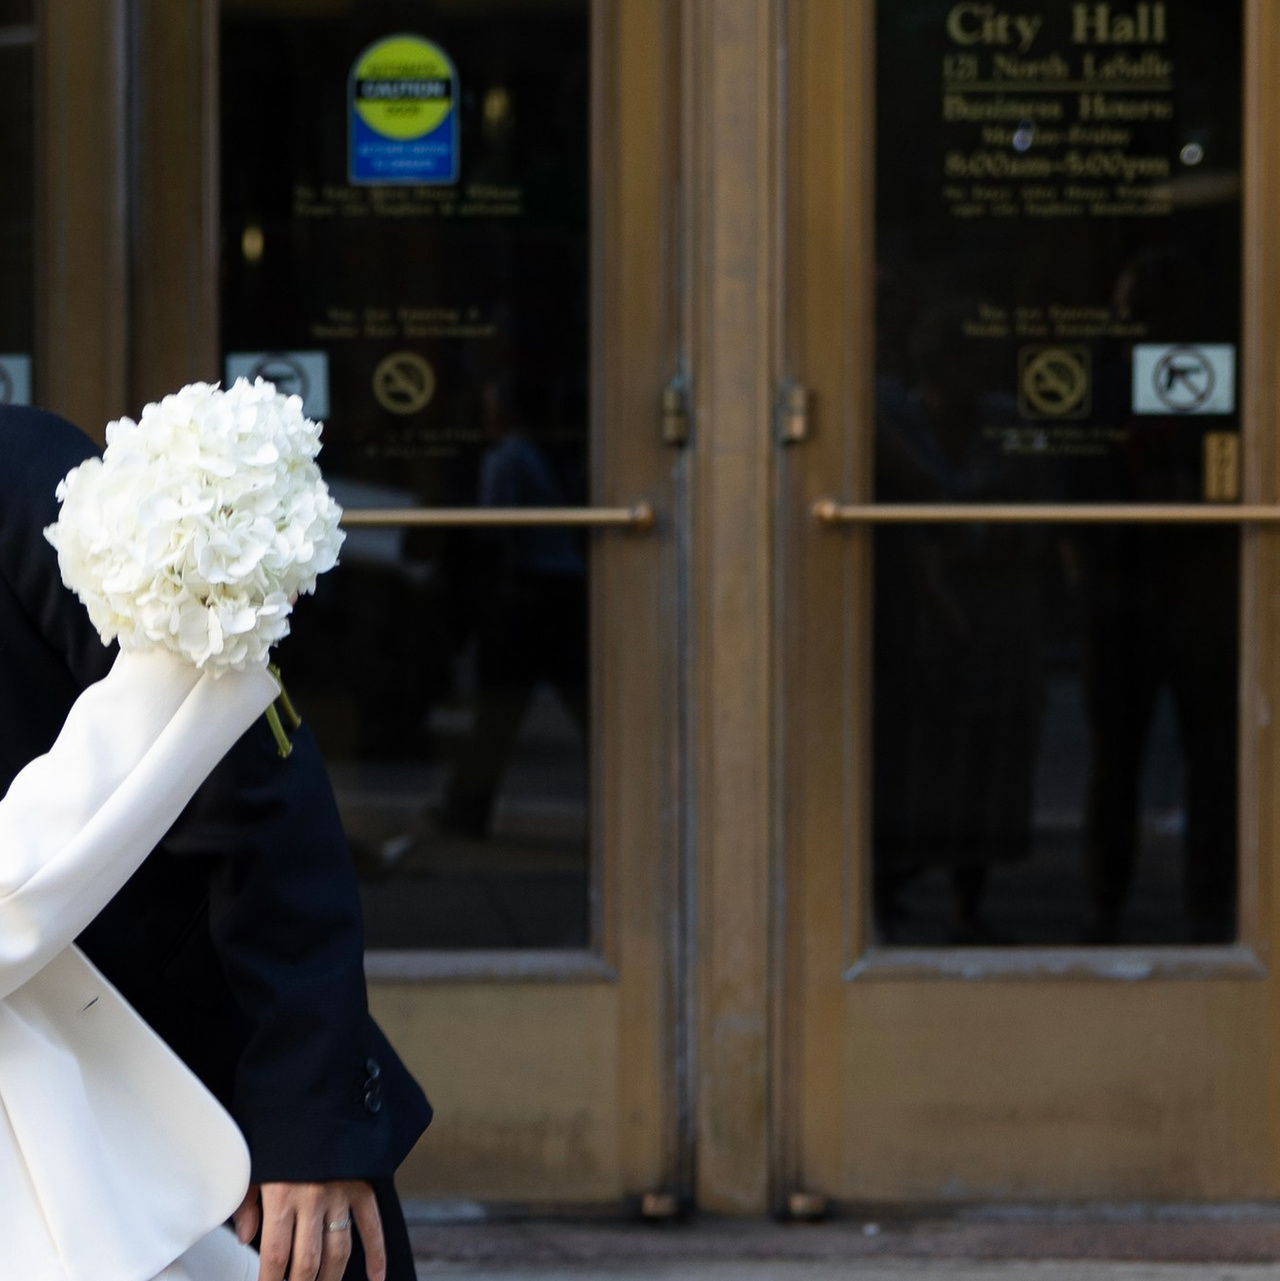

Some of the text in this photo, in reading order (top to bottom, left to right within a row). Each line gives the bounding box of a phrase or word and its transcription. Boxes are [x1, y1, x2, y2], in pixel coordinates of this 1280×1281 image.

[946, 1, 1166, 52] City Hall
[994, 53, 1068, 79] North
